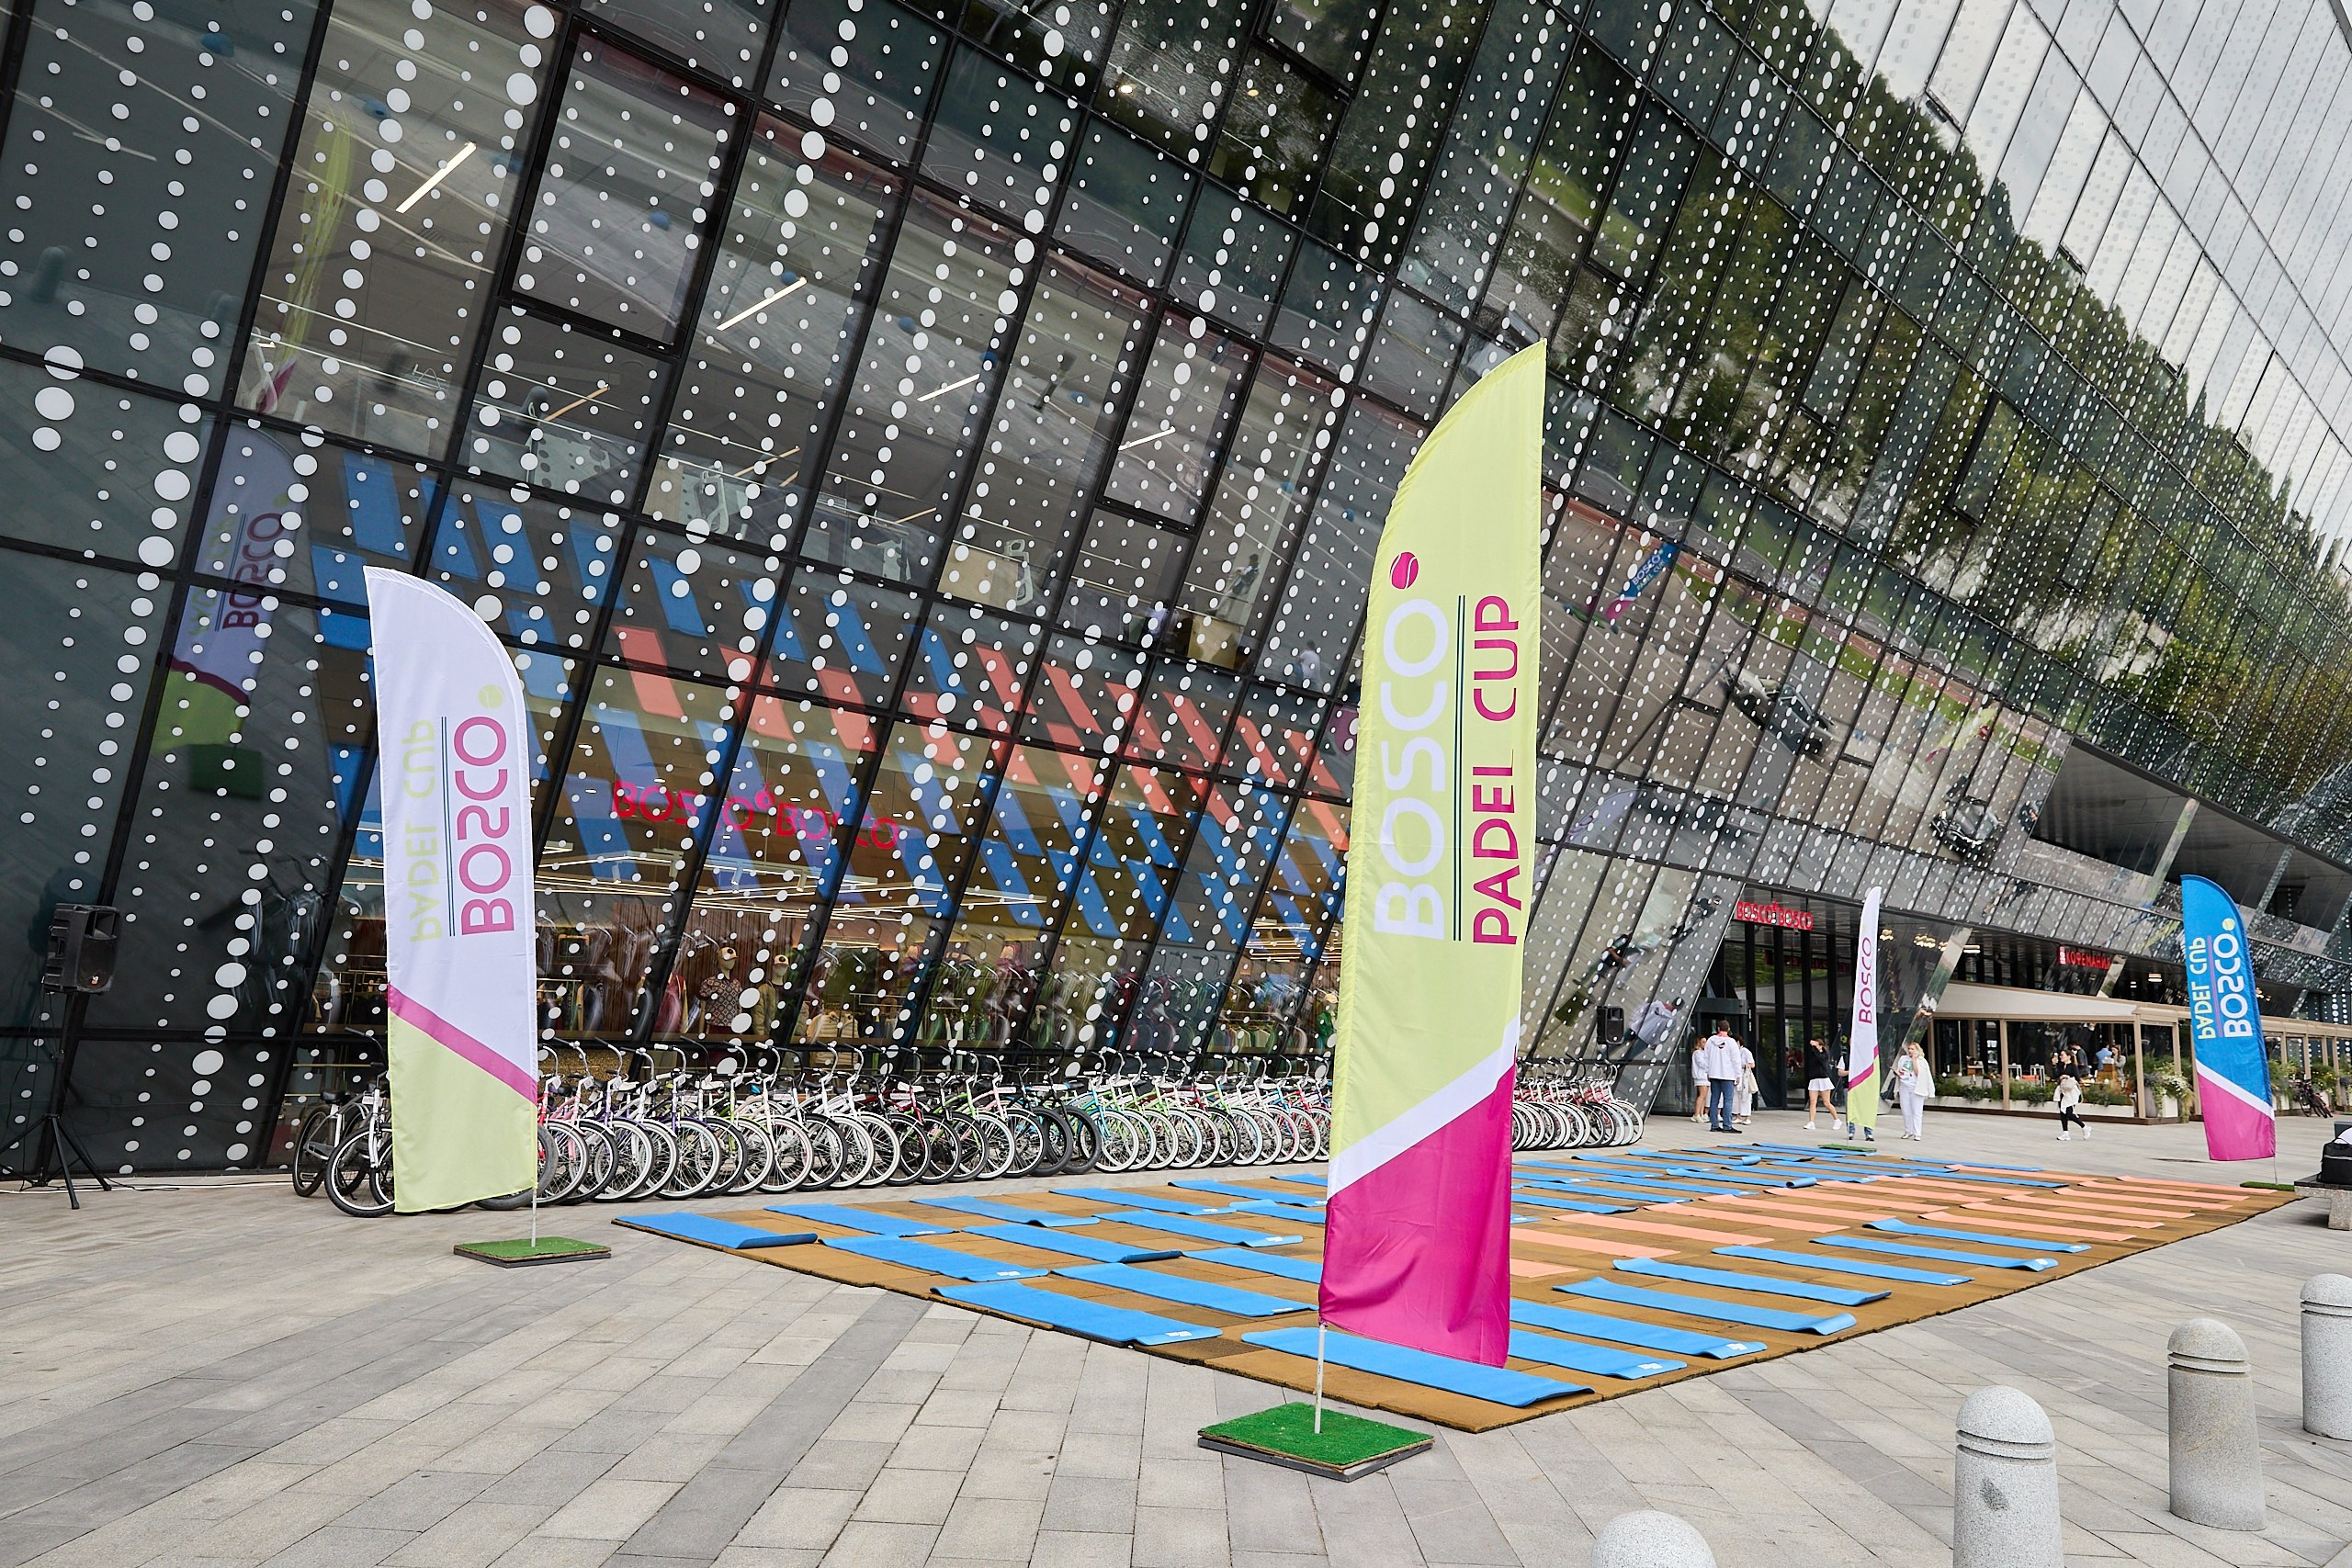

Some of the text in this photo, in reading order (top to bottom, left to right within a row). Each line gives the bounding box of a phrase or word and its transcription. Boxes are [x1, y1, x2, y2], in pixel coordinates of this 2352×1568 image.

[1374, 598, 1449, 941] BOSCO
[1472, 595, 1521, 945] PADEL CUP
[612, 780, 899, 850] BOSO BOO
[1736, 900, 1814, 931] BOSCO BOSCO
[1859, 936, 1872, 1024] BOSCO
